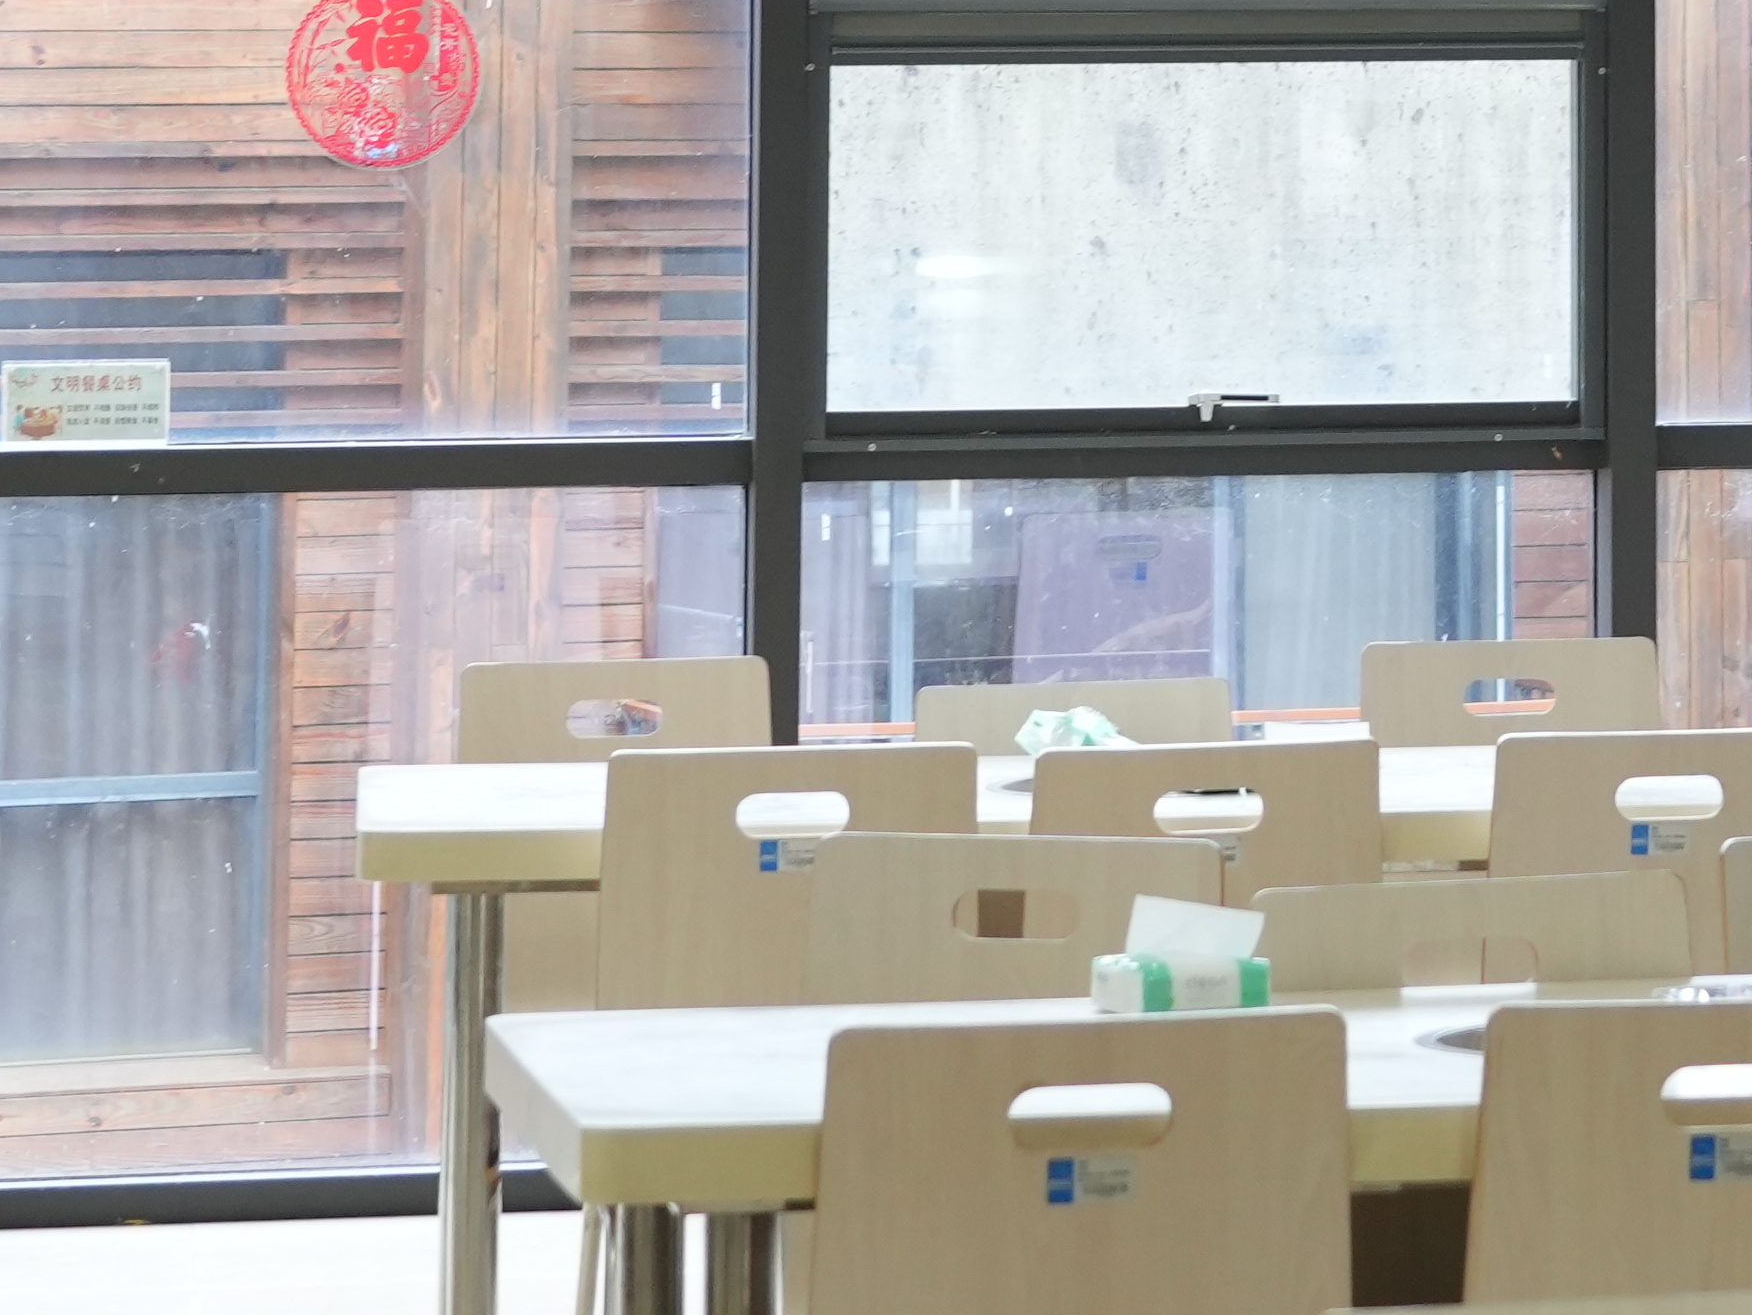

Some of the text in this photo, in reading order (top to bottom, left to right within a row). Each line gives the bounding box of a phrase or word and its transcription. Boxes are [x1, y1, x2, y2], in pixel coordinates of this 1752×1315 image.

[50, 375, 143, 392] 文明餐桌公约
